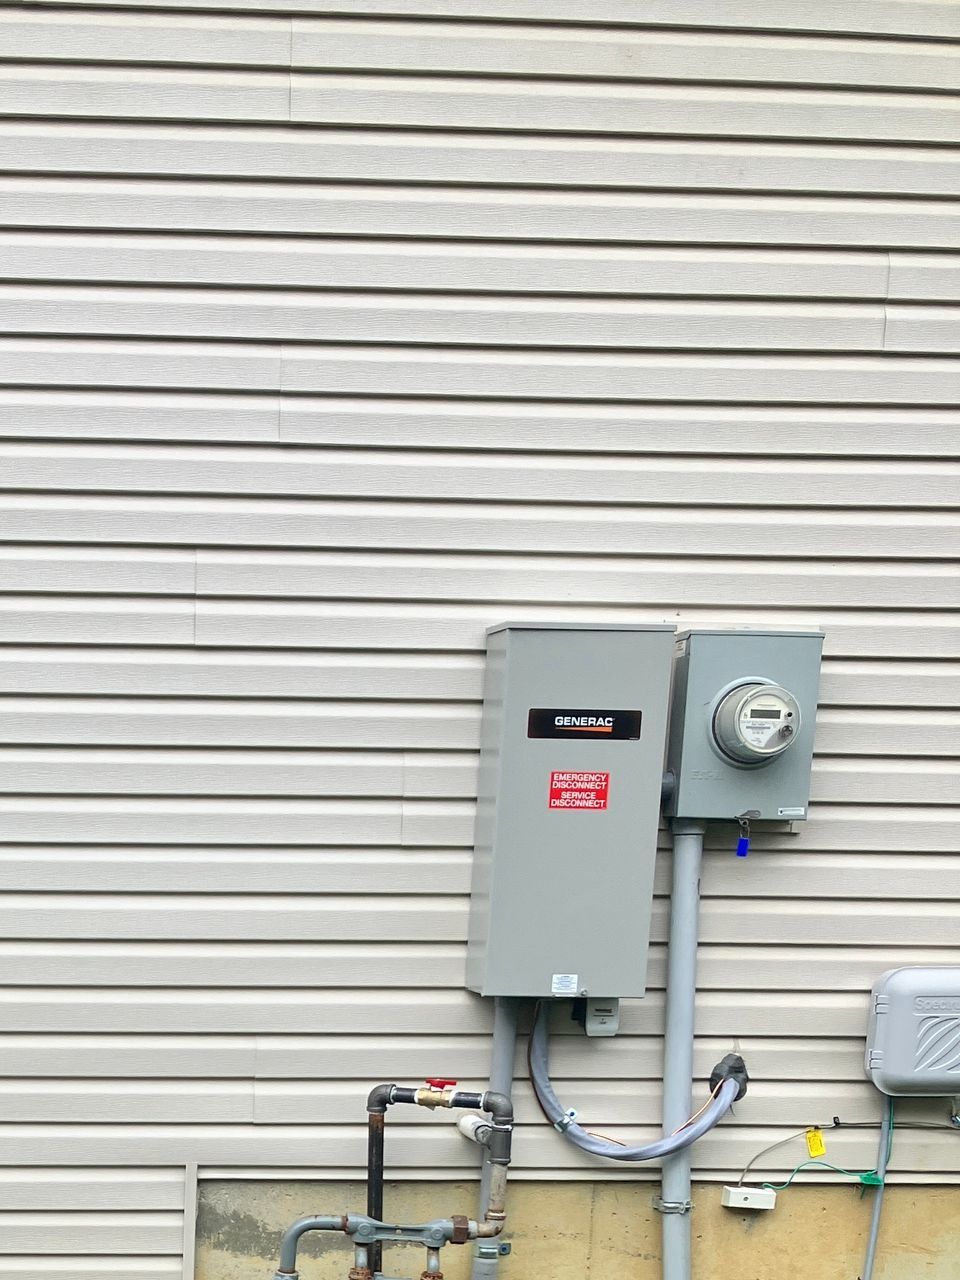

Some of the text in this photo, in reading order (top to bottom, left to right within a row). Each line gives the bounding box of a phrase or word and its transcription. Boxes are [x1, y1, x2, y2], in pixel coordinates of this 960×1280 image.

[554, 716, 613, 726] GENERAC
[553, 773, 607, 782] EMERGENCY
[552, 781, 607, 790] DISCONNECT
[560, 791, 597, 800] SERVICE
[550, 799, 606, 808] DISCONNECT
